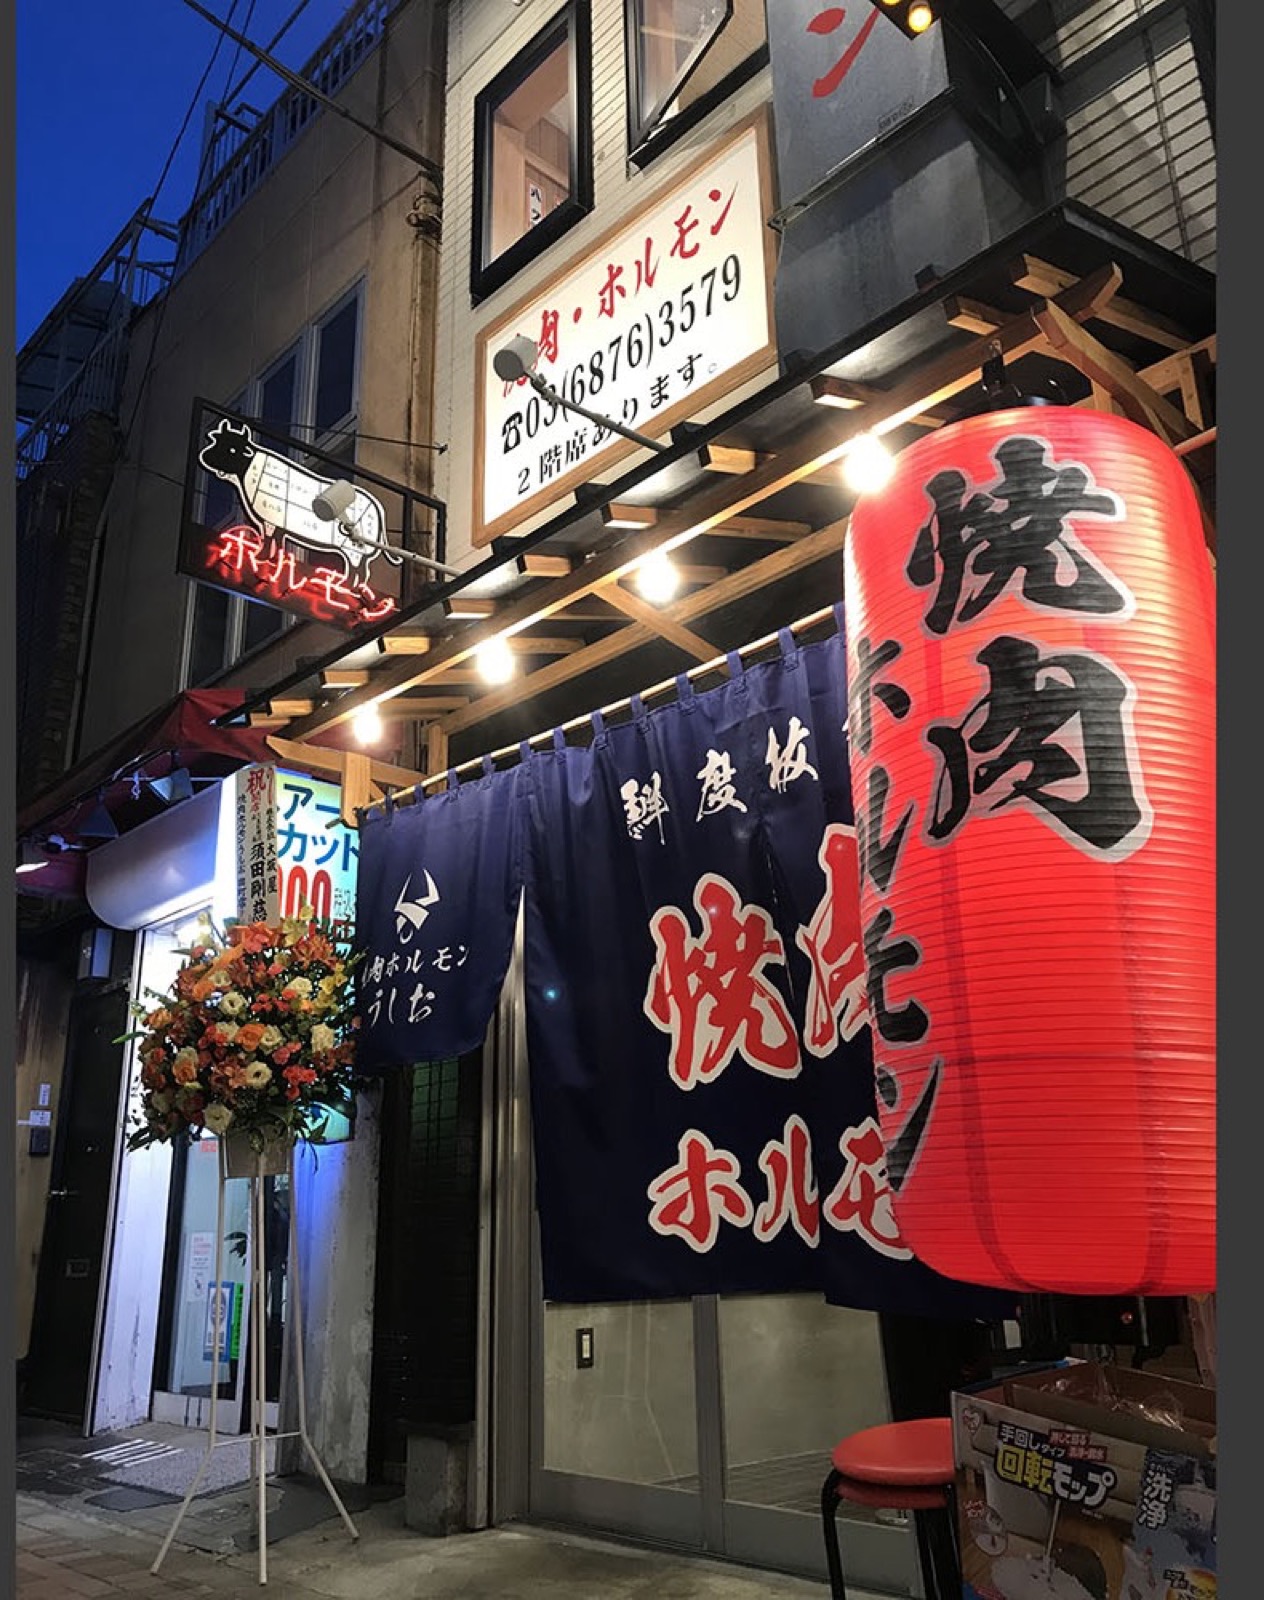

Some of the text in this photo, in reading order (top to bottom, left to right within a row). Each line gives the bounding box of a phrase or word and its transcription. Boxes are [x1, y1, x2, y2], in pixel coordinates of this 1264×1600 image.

[503, 181, 738, 398] 肉・ホルモン
[218, 529, 398, 619] ホルモン
[904, 434, 1156, 864] 焼肉
[276, 782, 341, 821] アー
[620, 716, 849, 846] 鮮度抜
[277, 823, 360, 872] カット
[361, 944, 470, 990] 肉ホルモン
[367, 982, 436, 1029] うしお
[997, 1443, 1116, 1508] 回転モップ
[1137, 1469, 1173, 1530] 洗浄
